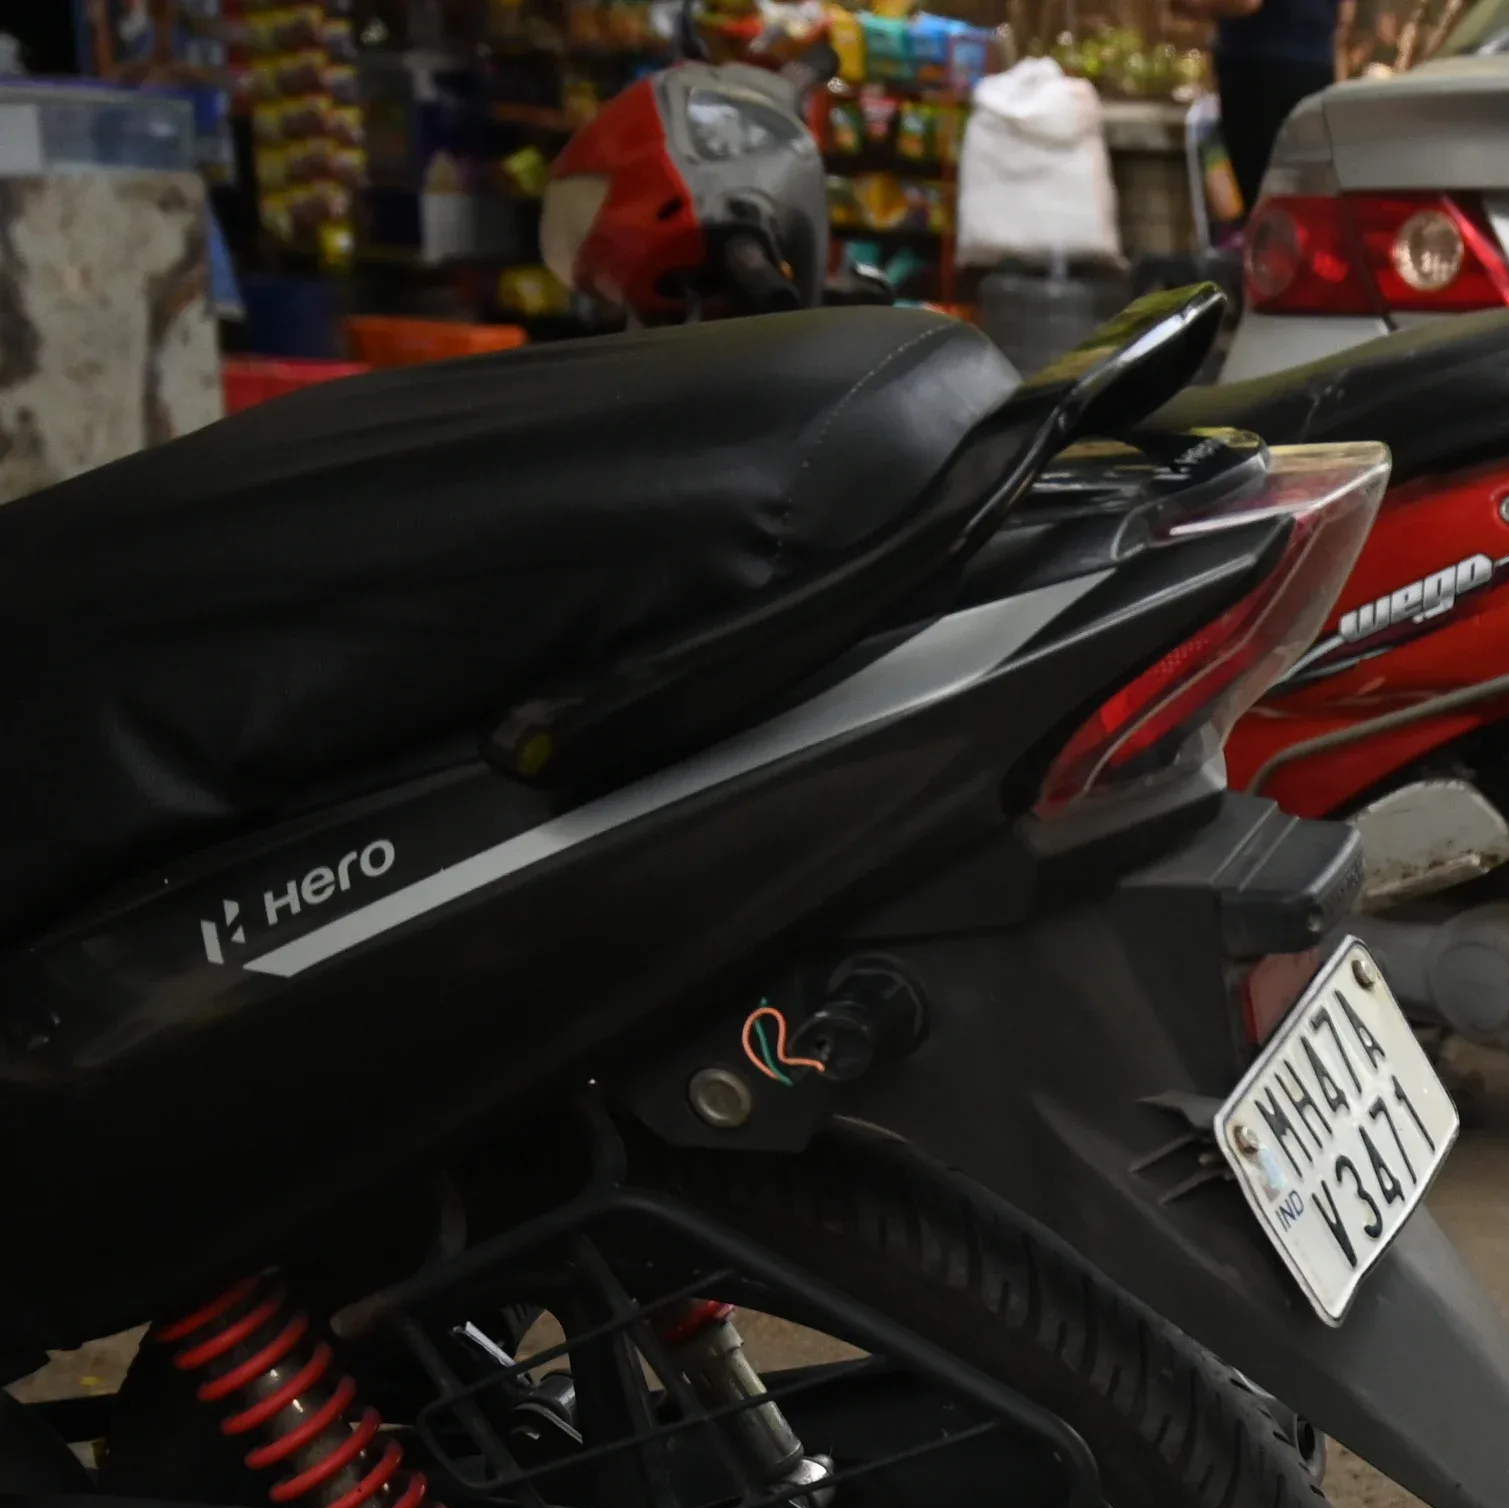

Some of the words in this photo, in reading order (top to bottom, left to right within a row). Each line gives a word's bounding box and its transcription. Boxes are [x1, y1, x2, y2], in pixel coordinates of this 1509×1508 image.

[263, 838, 395, 926] Hero
[1254, 989, 1386, 1180] MH47A
[1275, 1189, 1305, 1233] IND
[1312, 1074, 1436, 1269] V3471
